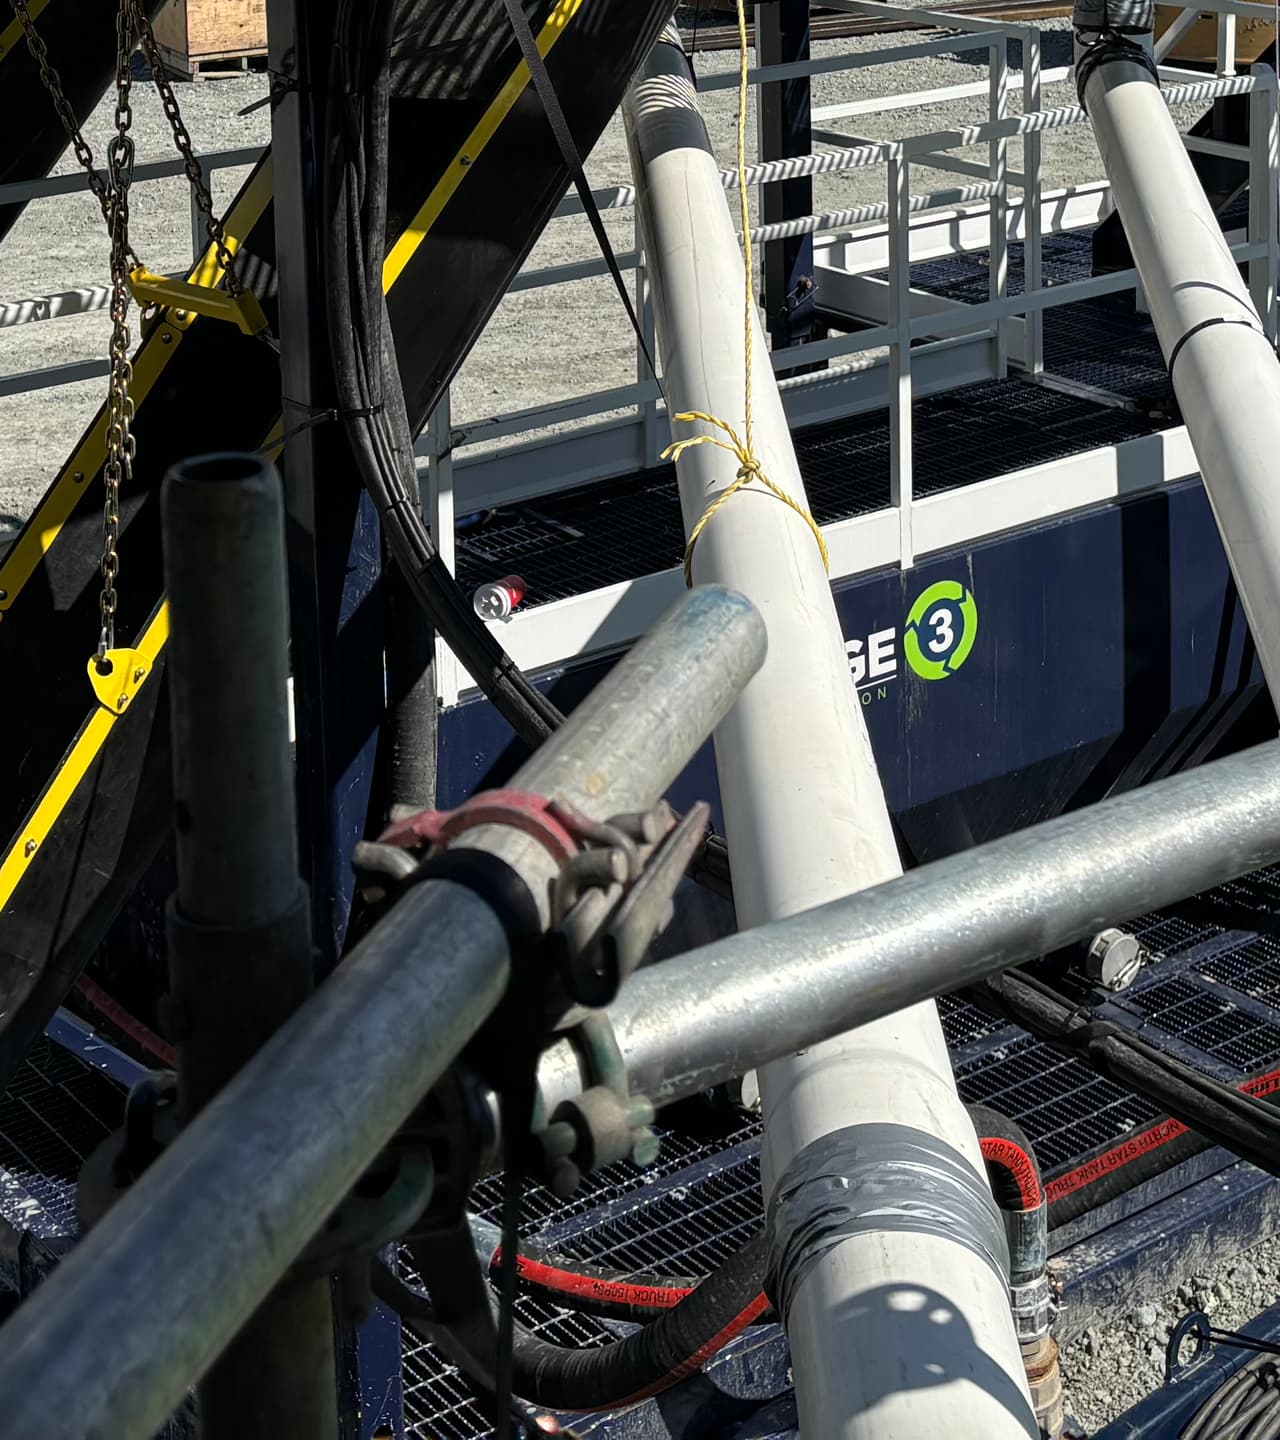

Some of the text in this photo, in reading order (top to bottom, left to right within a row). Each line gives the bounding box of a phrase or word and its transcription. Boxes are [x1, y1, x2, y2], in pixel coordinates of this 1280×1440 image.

[928, 608, 954, 653] 3
[1139, 1120, 1181, 1147] NORTH
[1108, 1143, 1137, 1166] STAR
[1076, 1161, 1107, 1182] TANK
[633, 1288, 671, 1304] TRUCK
